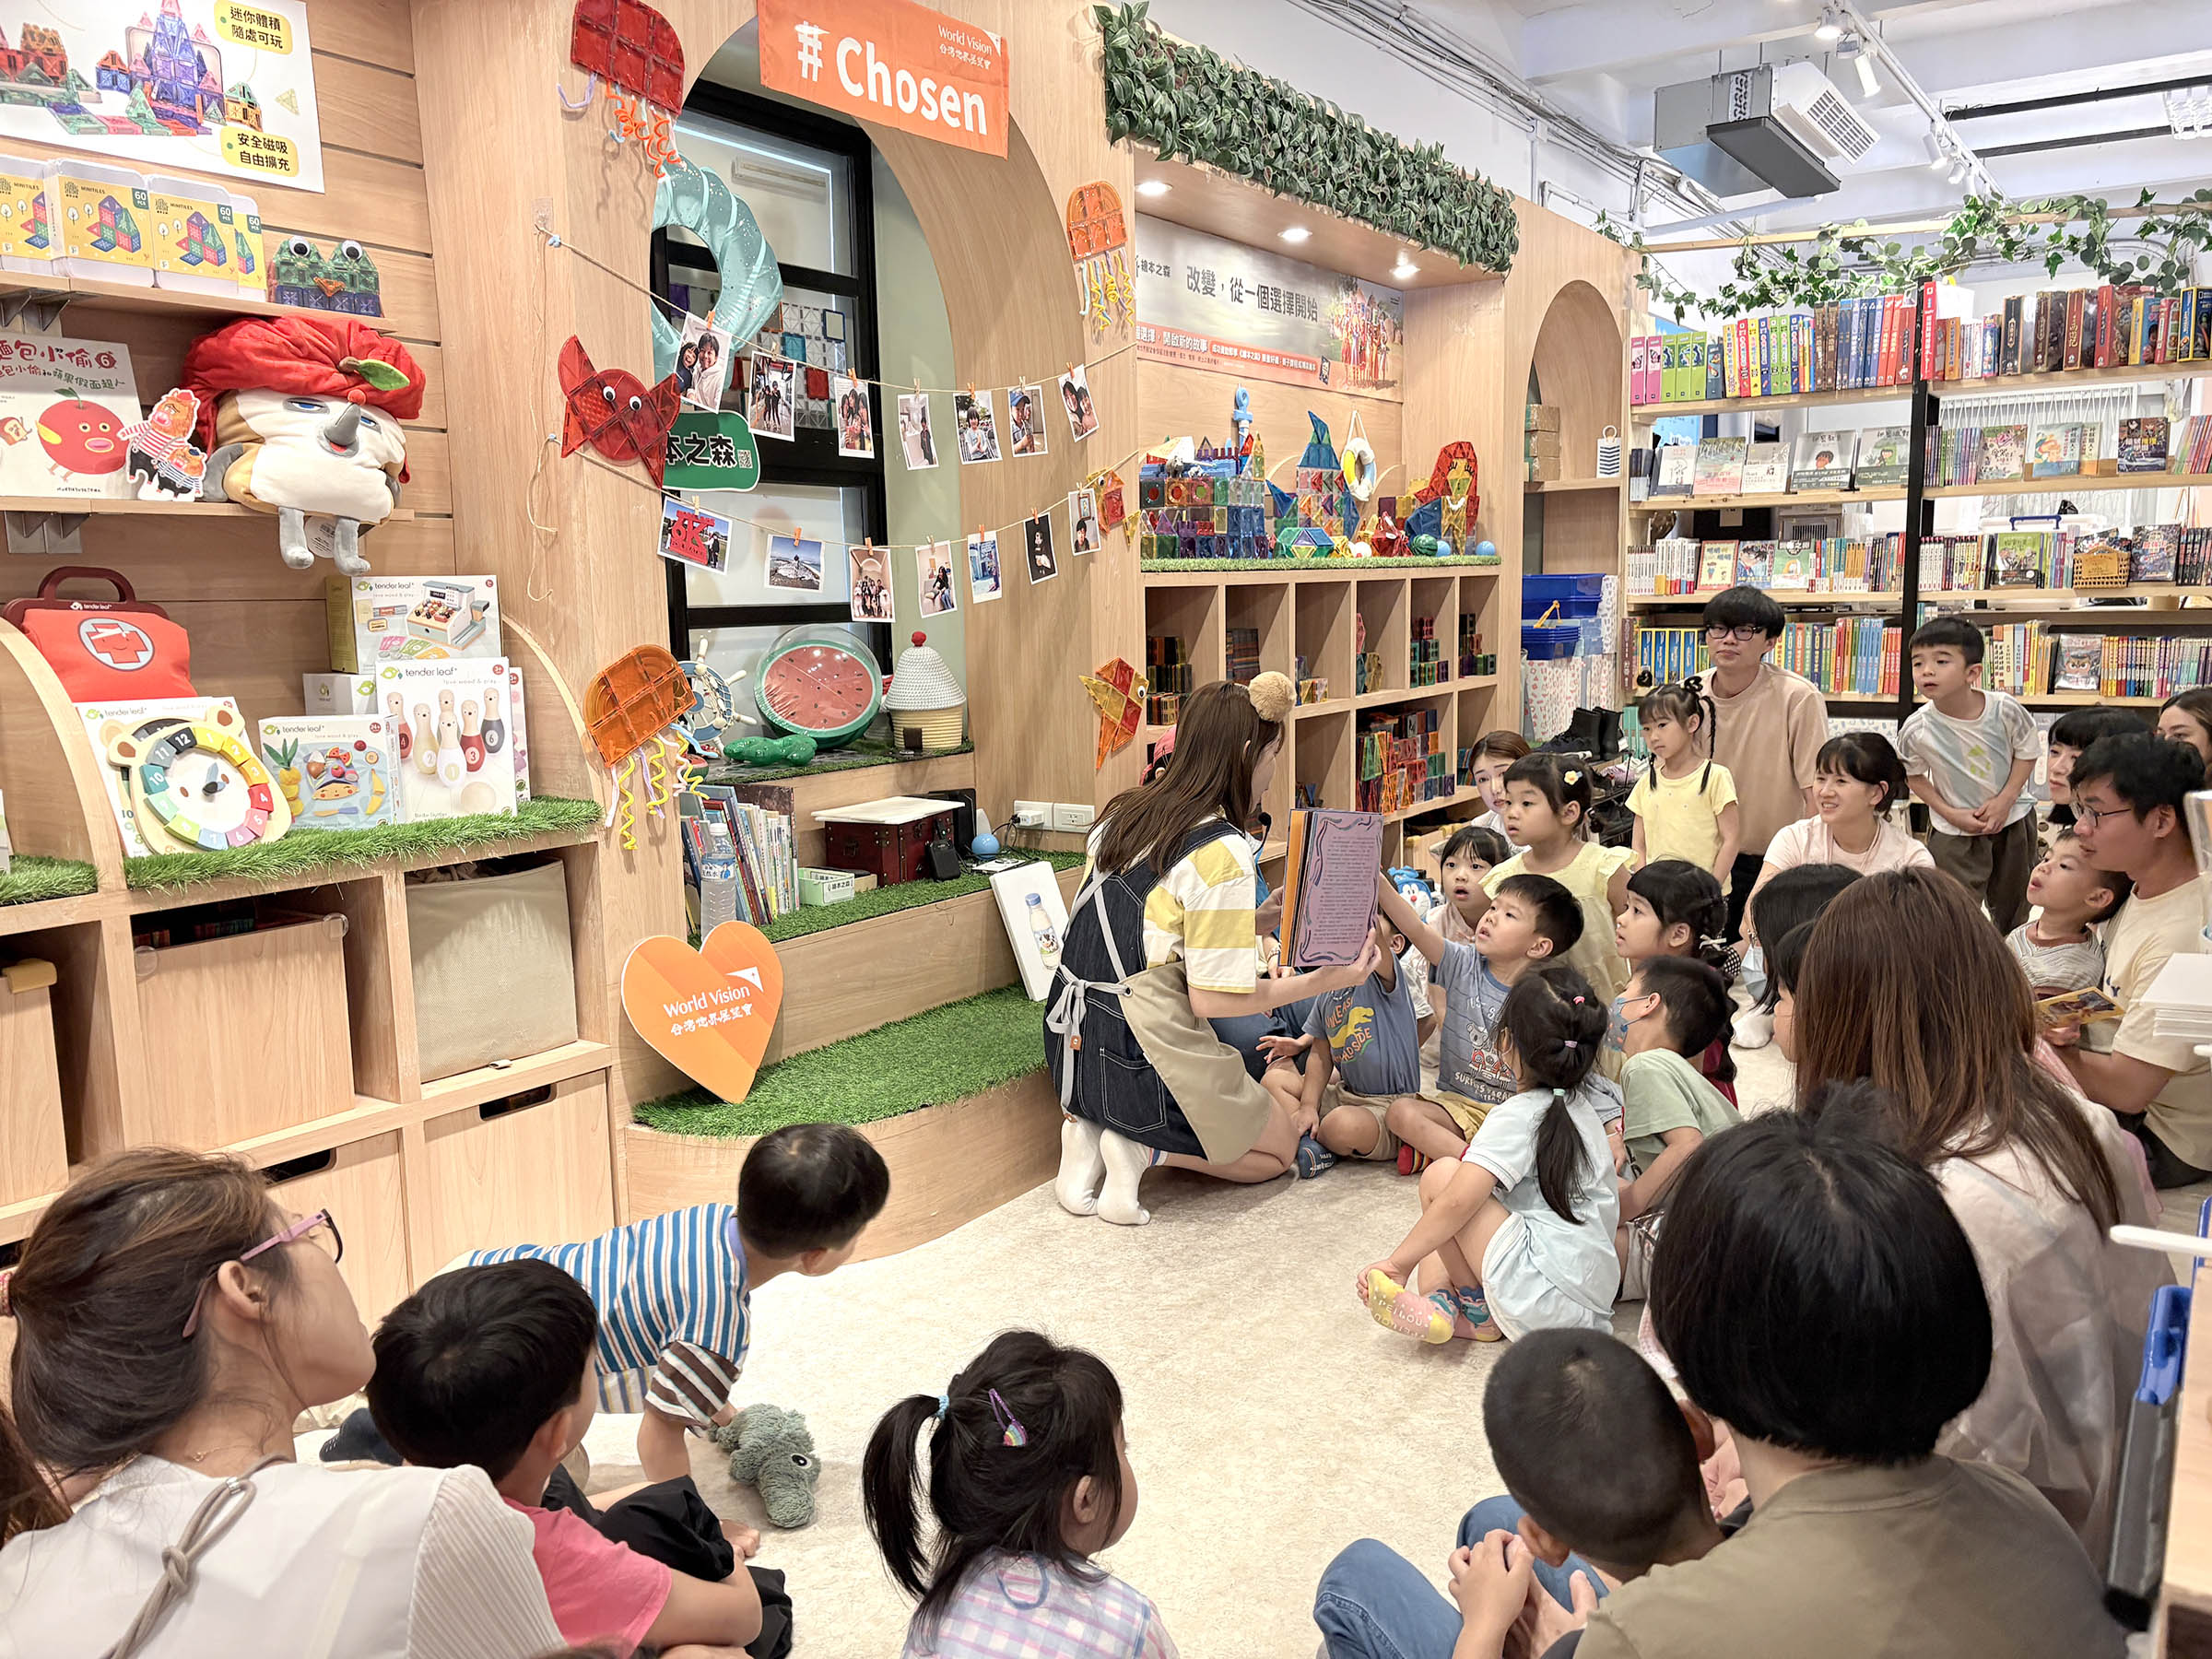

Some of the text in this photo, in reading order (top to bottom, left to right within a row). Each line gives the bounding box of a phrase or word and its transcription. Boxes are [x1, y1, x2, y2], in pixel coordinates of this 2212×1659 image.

[229, 6, 280, 31] 迷你體積
[231, 24, 283, 49] 隨處可玩
[938, 24, 993, 55] World Vision
[836, 36, 987, 135] Chosen
[237, 133, 288, 154] 安全磁吸
[240, 150, 290, 171] 自由擴充
[134, 191, 147, 201] 60
[219, 206, 231, 217] 60
[248, 217, 260, 226] 60
[1186, 265, 1318, 323] 改變，從一個選擇開始
[100, 353, 110, 365] 6
[406, 667, 454, 677] tender leaf
[104, 707, 128, 716] tender
[175, 734, 192, 747] 12
[206, 733, 214, 743] 1
[400, 737, 406, 747] 4
[488, 734, 494, 743] 6
[154, 747, 170, 761] 11
[231, 745, 241, 756] 2
[470, 751, 477, 761] 3
[427, 754, 433, 763] 2
[251, 766, 260, 777] 3
[149, 772, 165, 785] 10
[260, 793, 269, 803] 4
[122, 809, 135, 818] 10
[253, 815, 264, 826] 5
[236, 831, 244, 841] 6
[664, 985, 751, 1018] World Vision
[1351, 1028, 1372, 1053] SIDE
